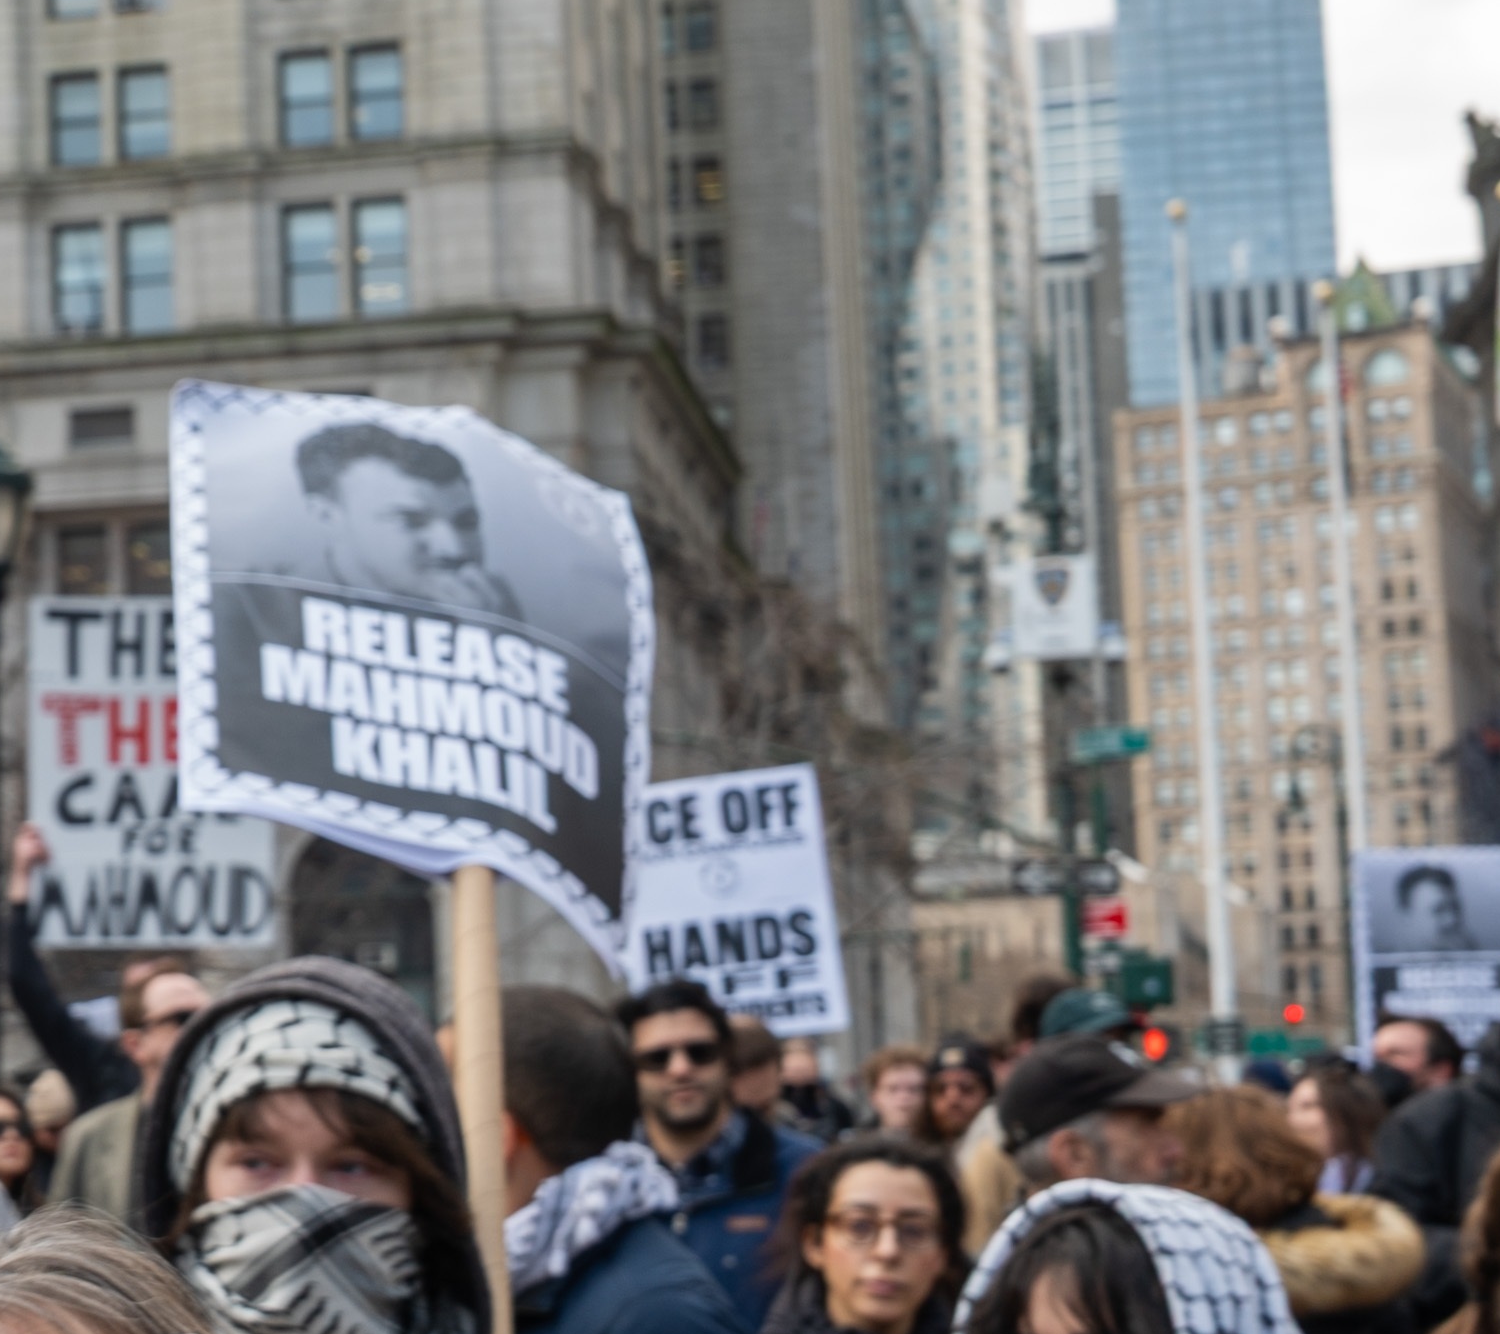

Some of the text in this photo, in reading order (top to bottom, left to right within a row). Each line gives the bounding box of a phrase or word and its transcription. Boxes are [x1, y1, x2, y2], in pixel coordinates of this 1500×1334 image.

[301, 596, 571, 715] RELEASE
[259, 643, 600, 800] MAHMOUD
[332, 716, 558, 835] KHALIL
[720, 782, 800, 834] OFF
[644, 911, 816, 973] HANDS
